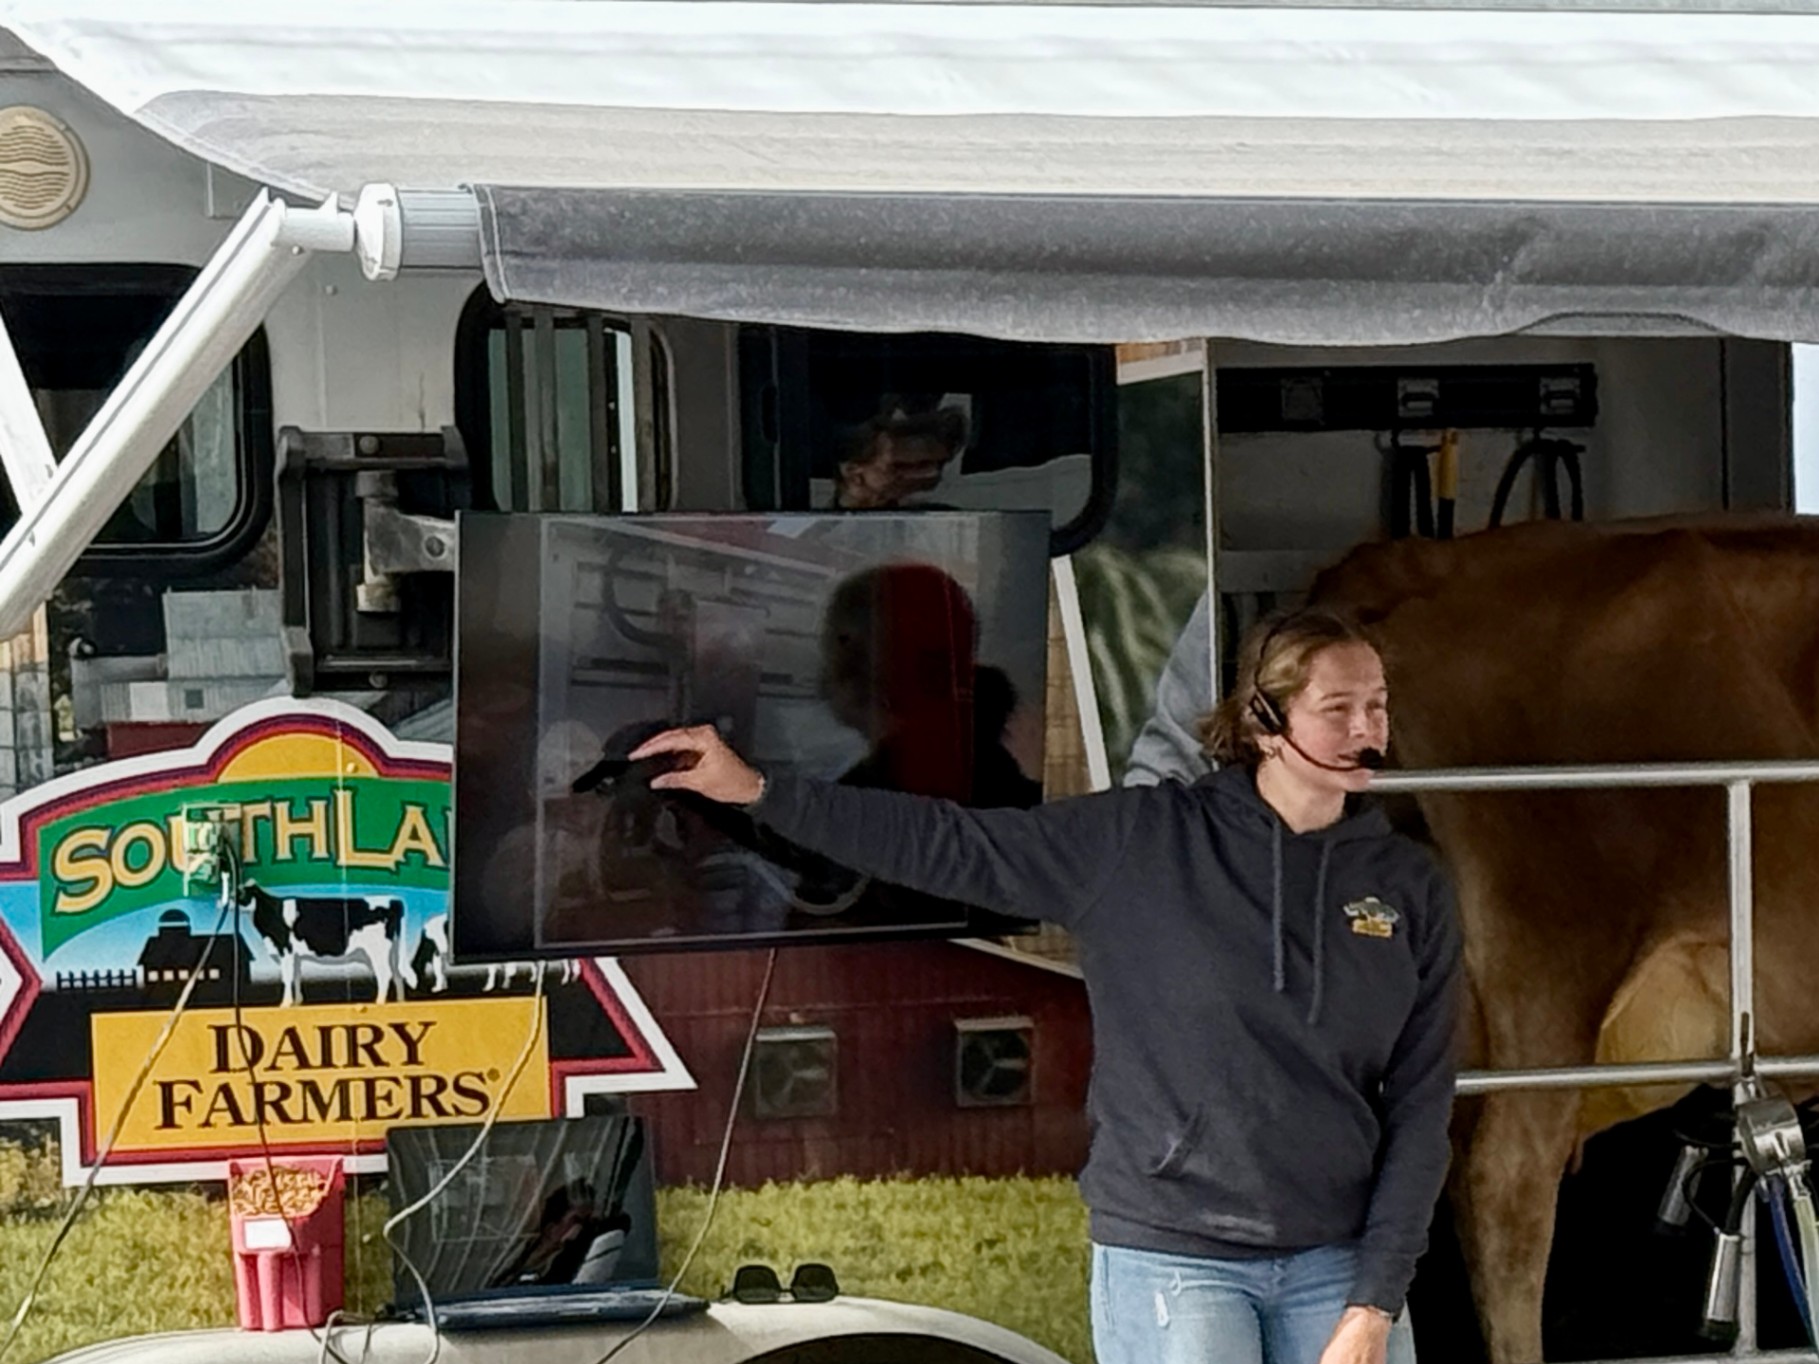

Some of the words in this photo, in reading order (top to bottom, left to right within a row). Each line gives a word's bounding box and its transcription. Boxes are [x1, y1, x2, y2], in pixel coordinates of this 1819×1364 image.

[53, 788, 453, 914] SOTHLA
[207, 1021, 437, 1074] DAIRY
[153, 1071, 491, 1130] FARMERS
